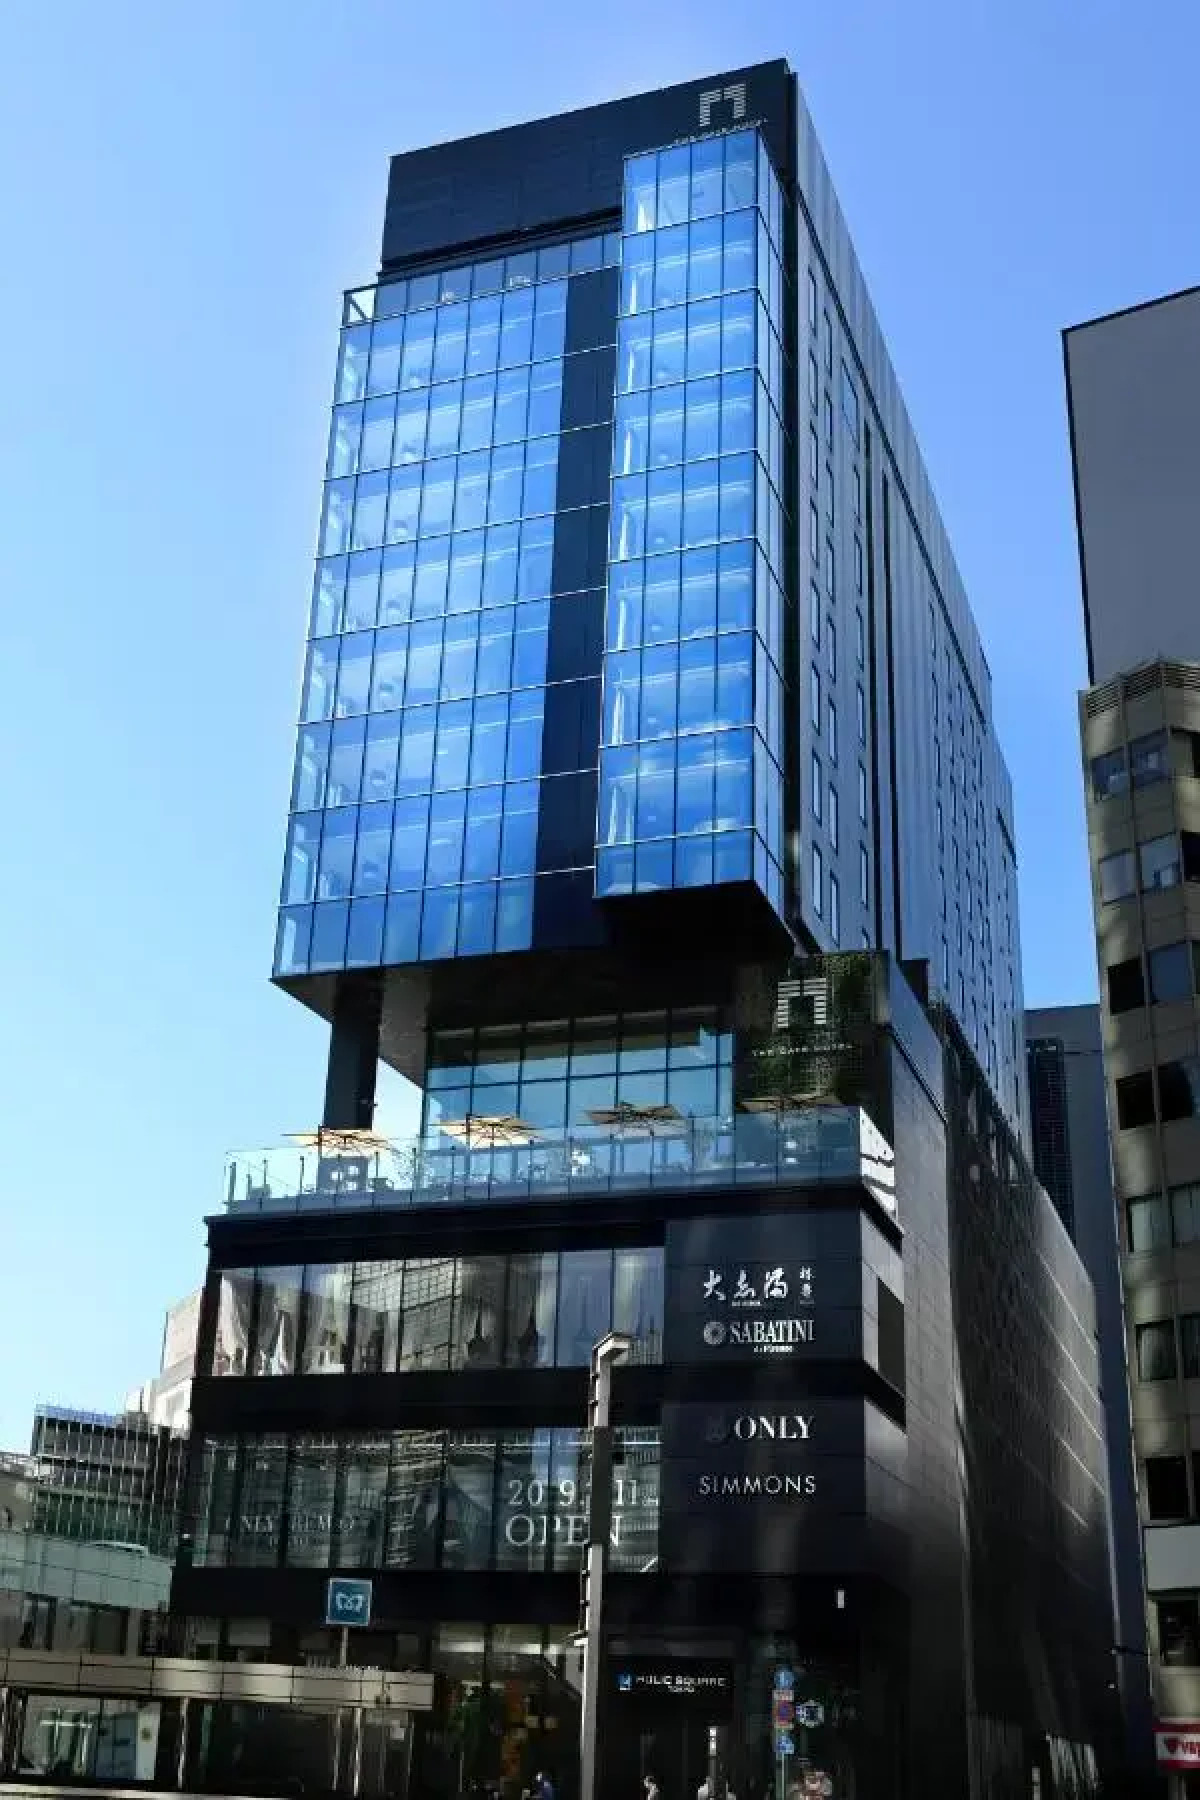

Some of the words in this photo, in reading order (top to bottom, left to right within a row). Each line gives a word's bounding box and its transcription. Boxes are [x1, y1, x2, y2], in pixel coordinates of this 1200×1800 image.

[730, 1319, 815, 1343] SABATINI
[734, 1415, 815, 1439] ONLY
[699, 1475, 817, 1495] SIMMONS
